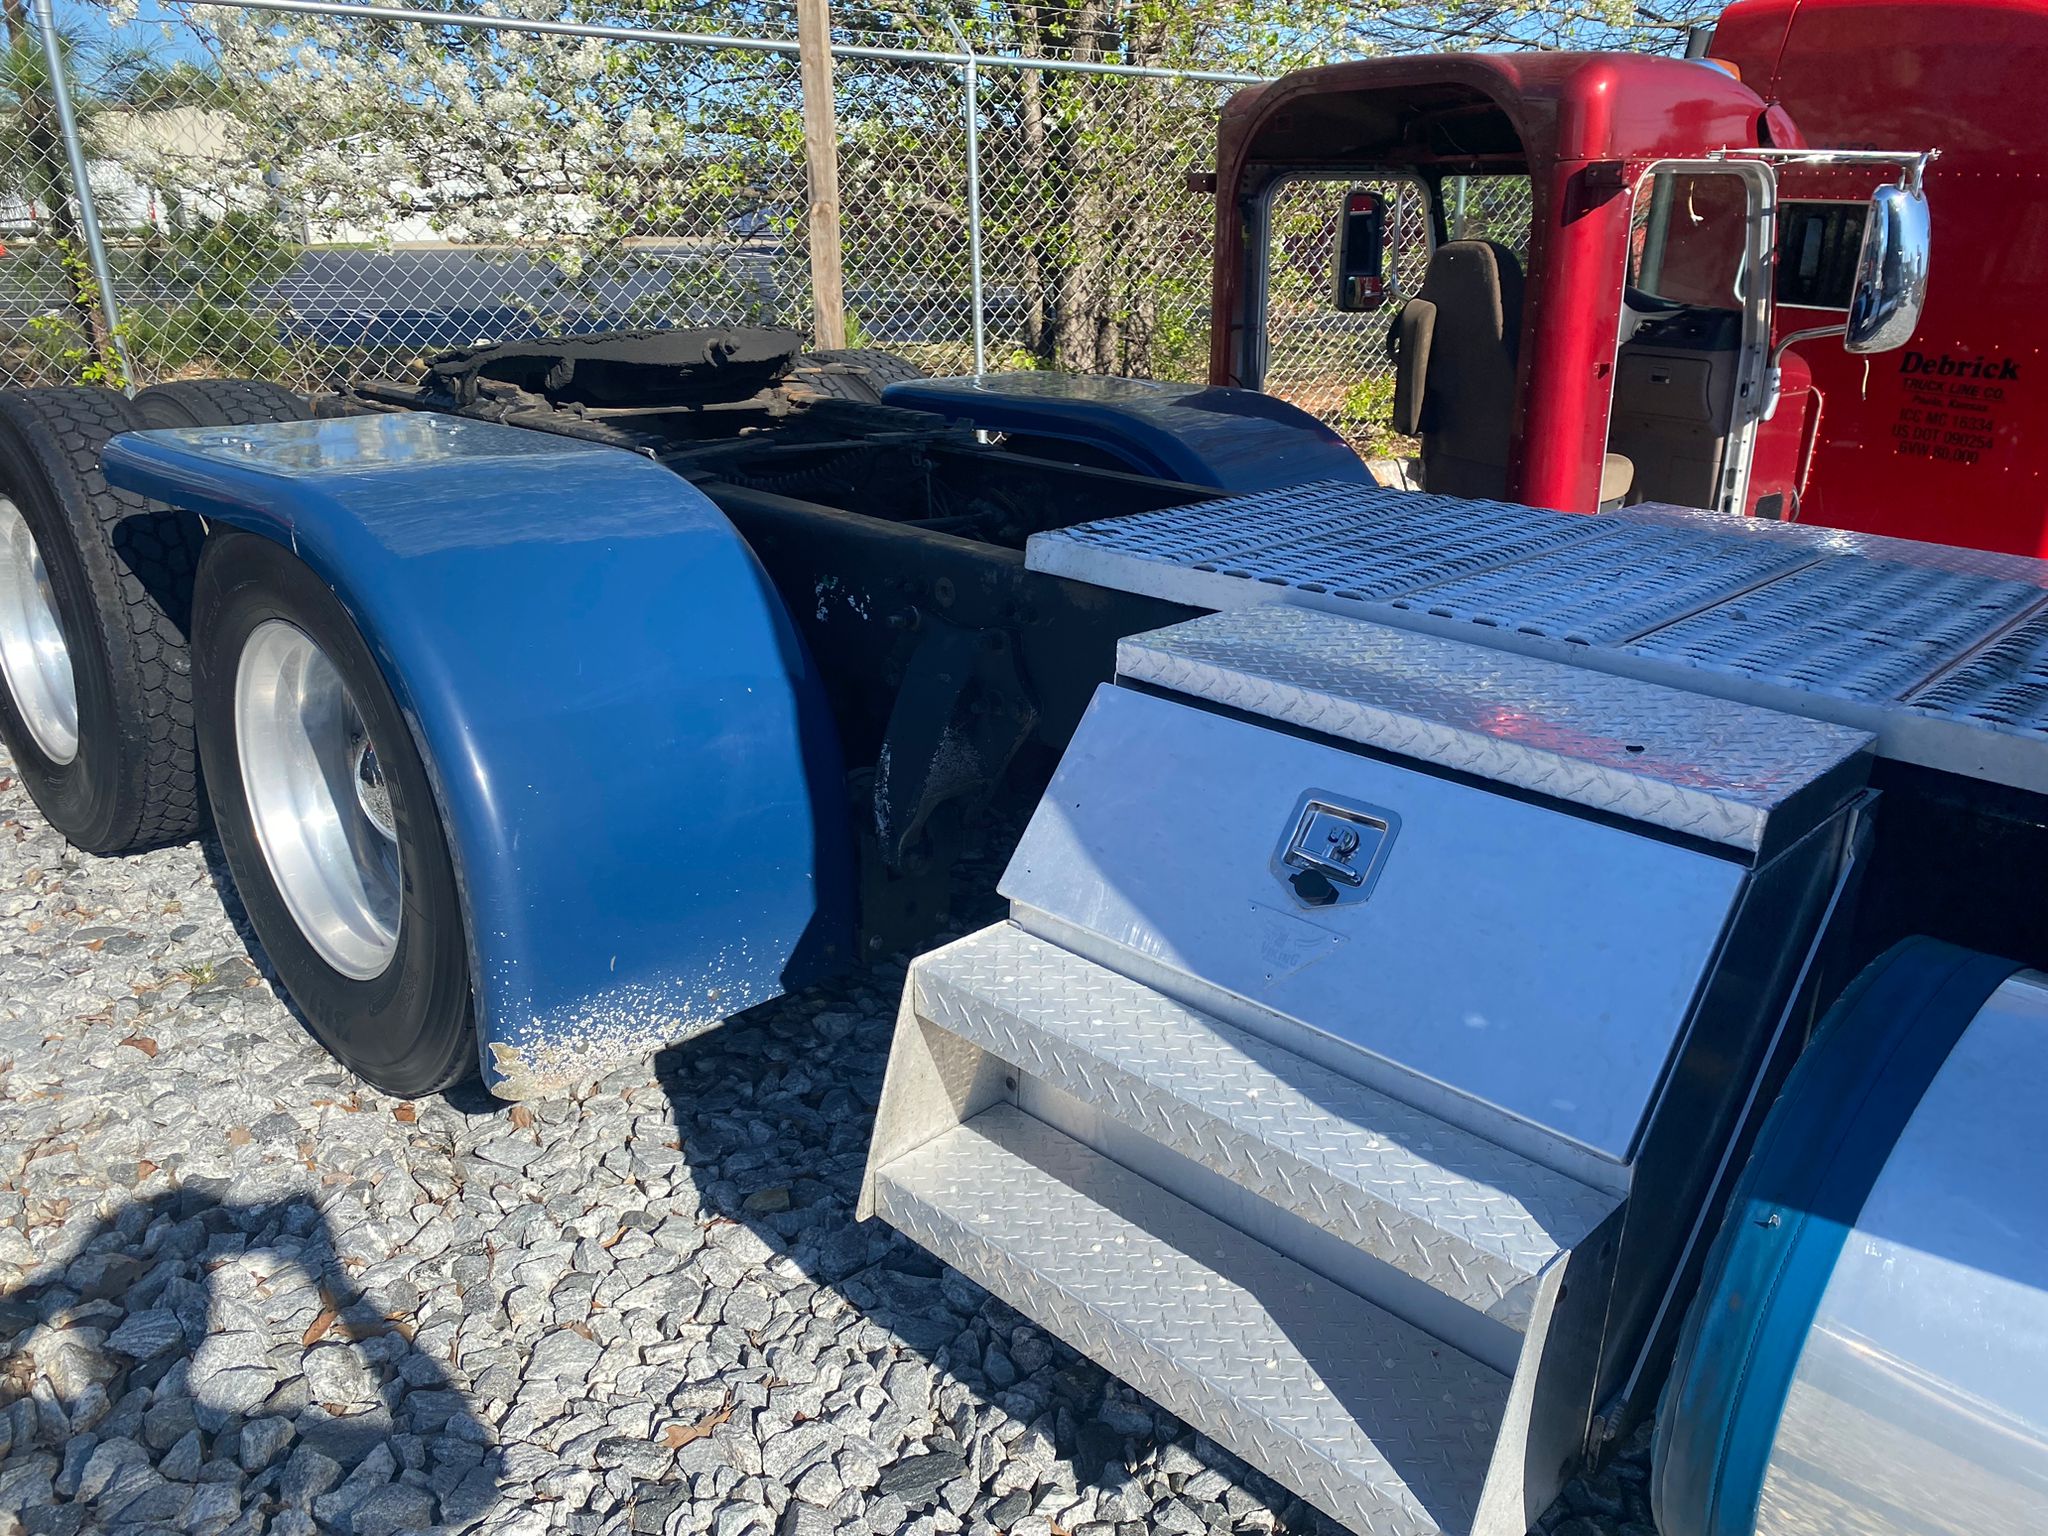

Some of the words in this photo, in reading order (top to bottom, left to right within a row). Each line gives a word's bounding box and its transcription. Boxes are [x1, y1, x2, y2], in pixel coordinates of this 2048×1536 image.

[1900, 352, 2021, 380] Debrick
[1904, 378, 1945, 392] TRUCK
[1951, 383, 1979, 396] LINE
[1900, 408, 1922, 423] ICC
[1926, 412, 1948, 426] MC
[1953, 416, 1993, 432] 16334
[1892, 424, 1909, 438] US
[1913, 427, 1940, 441] DOT
[1900, 440, 1929, 456] GVW
